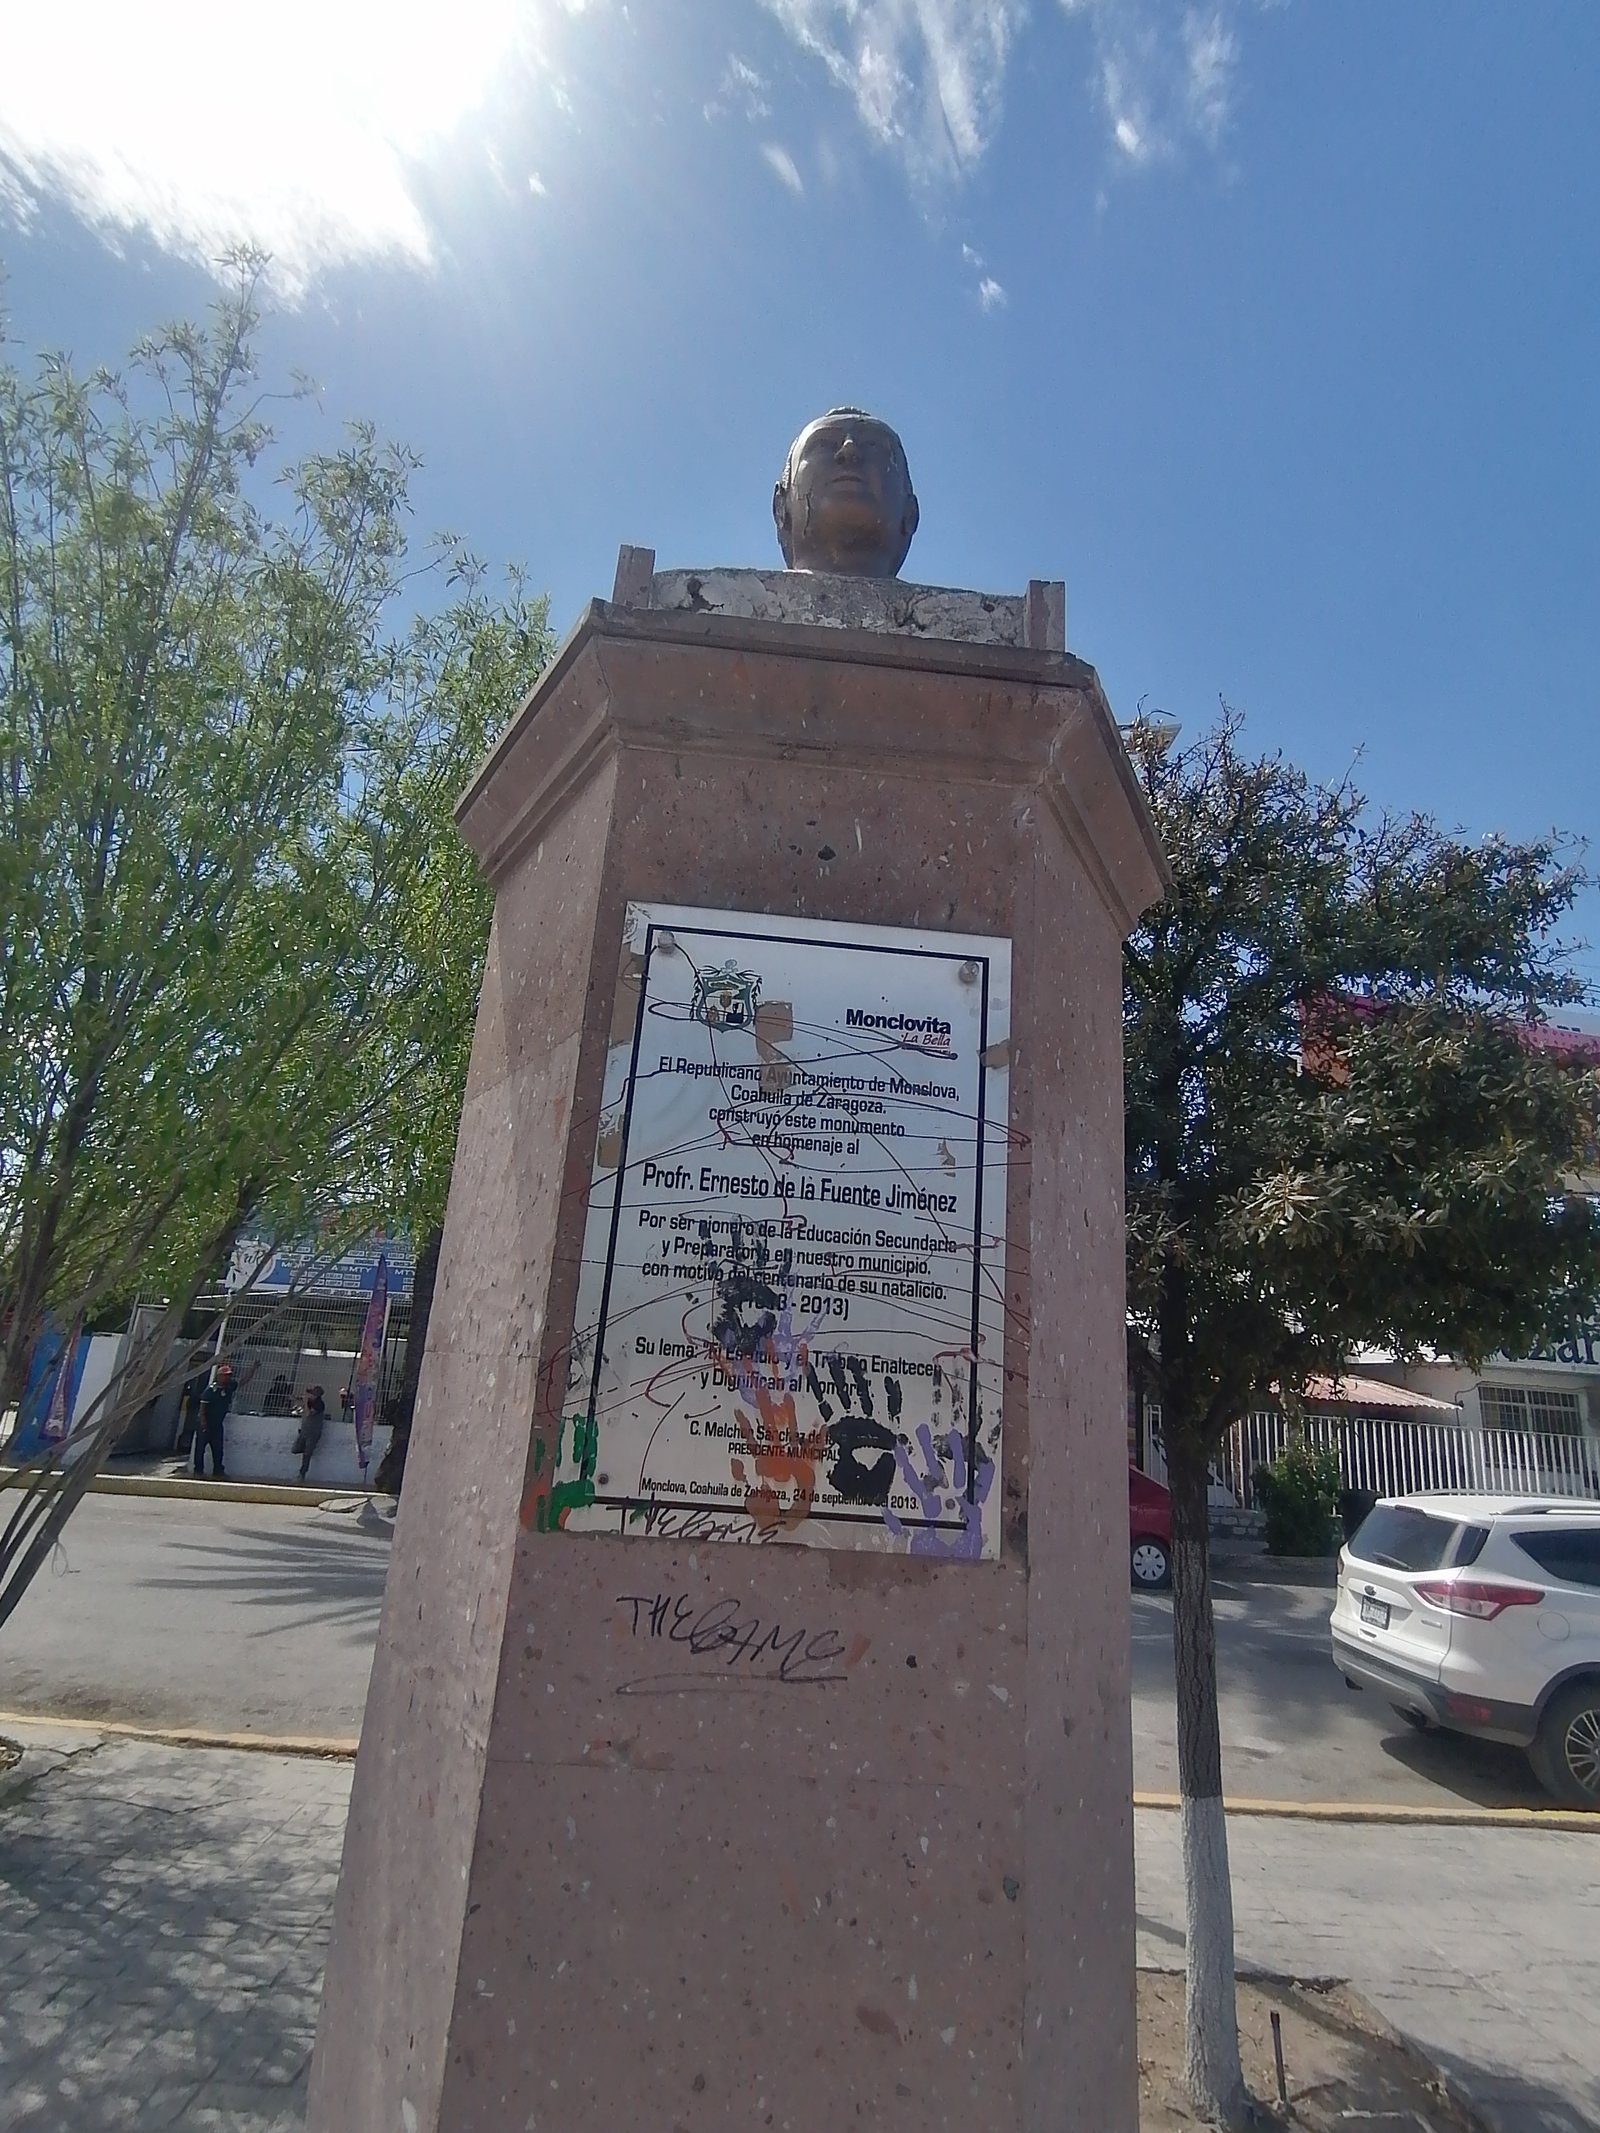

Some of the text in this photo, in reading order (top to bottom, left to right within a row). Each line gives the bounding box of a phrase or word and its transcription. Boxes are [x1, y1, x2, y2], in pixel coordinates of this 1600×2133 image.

[846, 1009, 951, 1034] Monclovita
[902, 1032, 951, 1046] La Bella
[659, 1056, 672, 1072] El
[869, 1076, 885, 1092] de
[731, 1084, 886, 1115] Coahuila de Zaragoza.
[709, 1107, 905, 1137] construyó este monumento
[752, 1131, 860, 1156] en homenaje al
[642, 1162, 957, 1213] Profr. Ernesto de la Fuente Jiménez
[639, 1210, 666, 1228] Por
[669, 1217, 694, 1231] ser
[758, 1220, 776, 1237] de
[781, 1221, 793, 1240] la
[797, 1222, 871, 1244] Educación
[662, 1240, 670, 1257] y
[797, 1250, 854, 1269] nuestro
[858, 1254, 931, 1277] municipio.
[642, 1262, 668, 1277] con
[673, 1261, 723, 1281] motivo
[838, 1275, 856, 1293] de
[859, 1281, 877, 1295] su
[881, 1280, 947, 1300] natalicio.
[635, 1336, 654, 1355] Su
[659, 1338, 698, 1359] lema:
[701, 1372, 709, 1390] y
[789, 1374, 802, 1392] al
[690, 1420, 701, 1436] C.
[728, 1441, 840, 1463] PRESIDENTE MUNICIPAL
[642, 1477, 687, 1495] Monclova,
[689, 1480, 728, 1496] Coahuila
[731, 1484, 741, 1497] de
[793, 1488, 806, 1501] 24
[890, 1495, 919, 1510] 2013.
